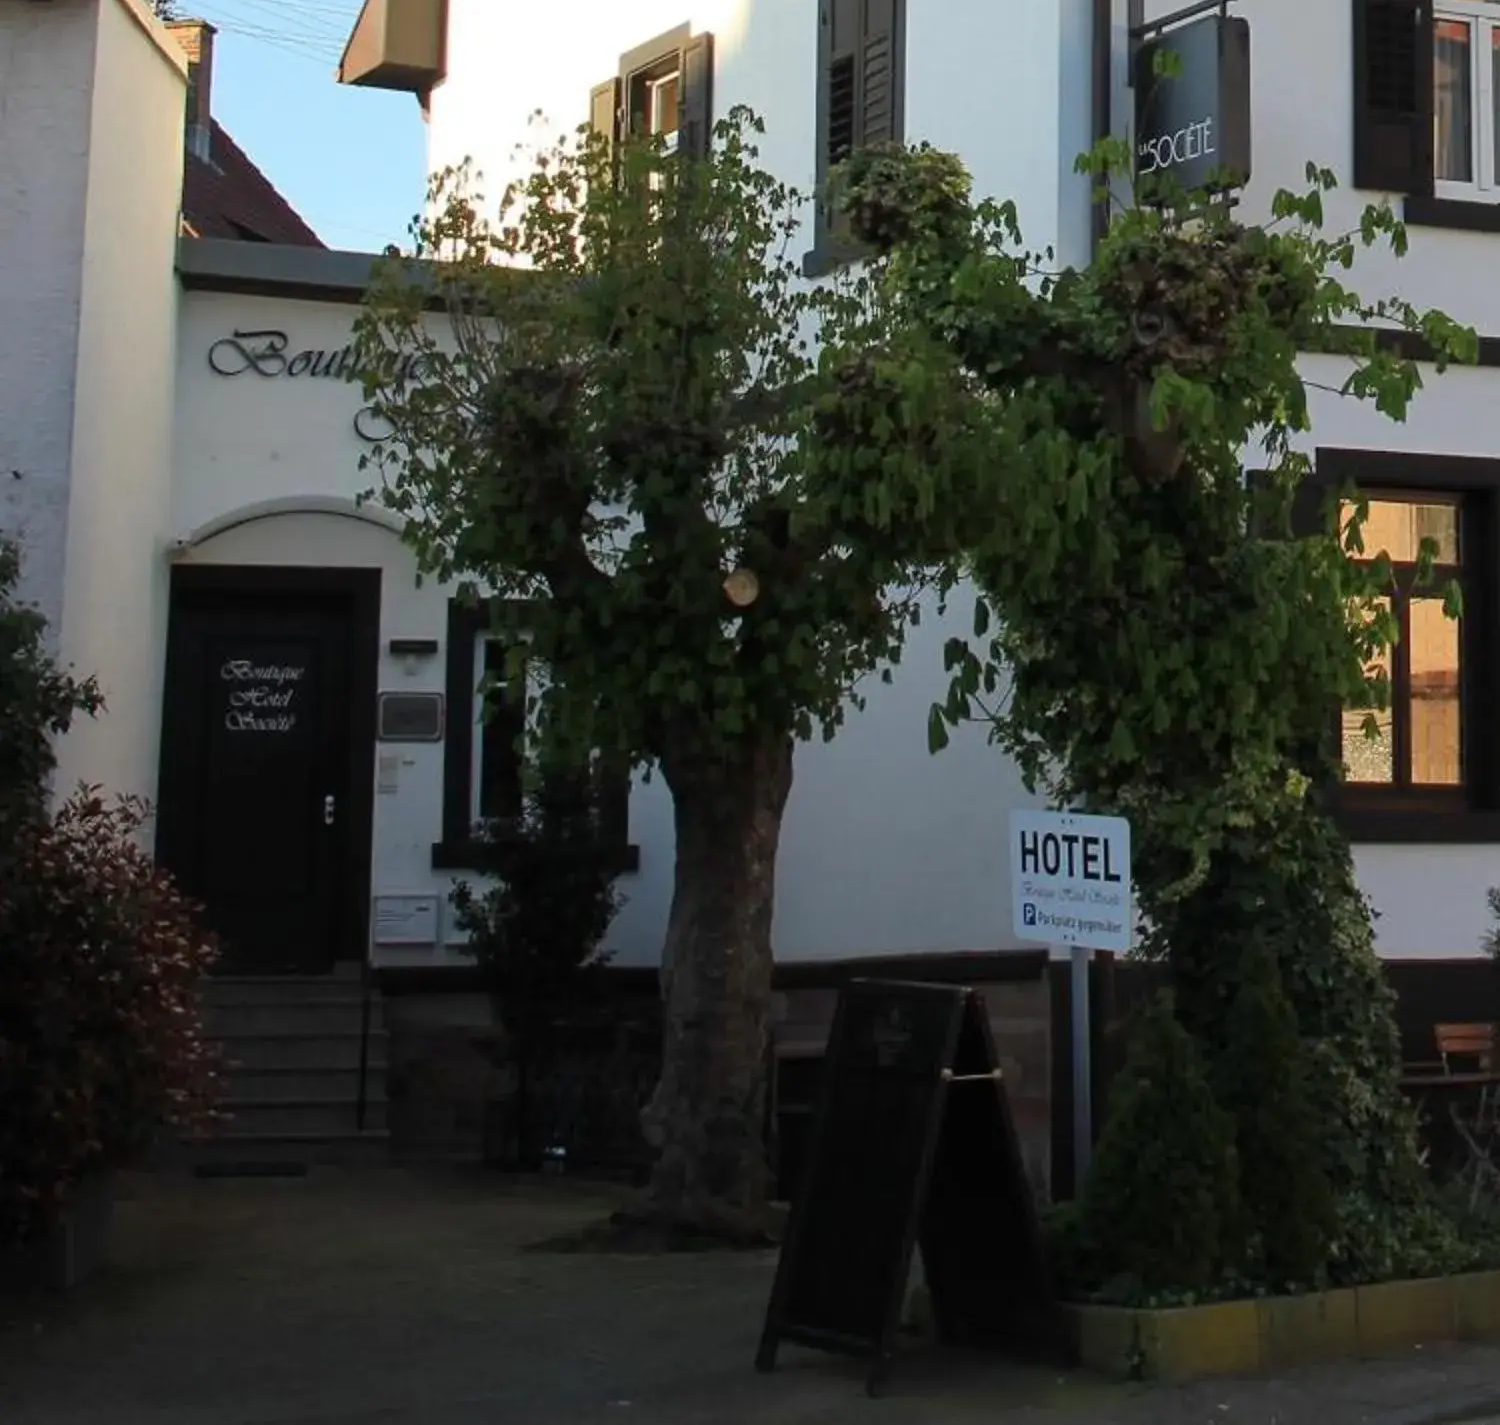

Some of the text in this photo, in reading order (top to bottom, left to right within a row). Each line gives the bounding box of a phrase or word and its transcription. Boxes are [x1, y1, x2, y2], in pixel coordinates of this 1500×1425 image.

[220, 659, 306, 687] Boutique
[229, 685, 295, 708] Hotel
[1020, 830, 1121, 882] HOTEL
